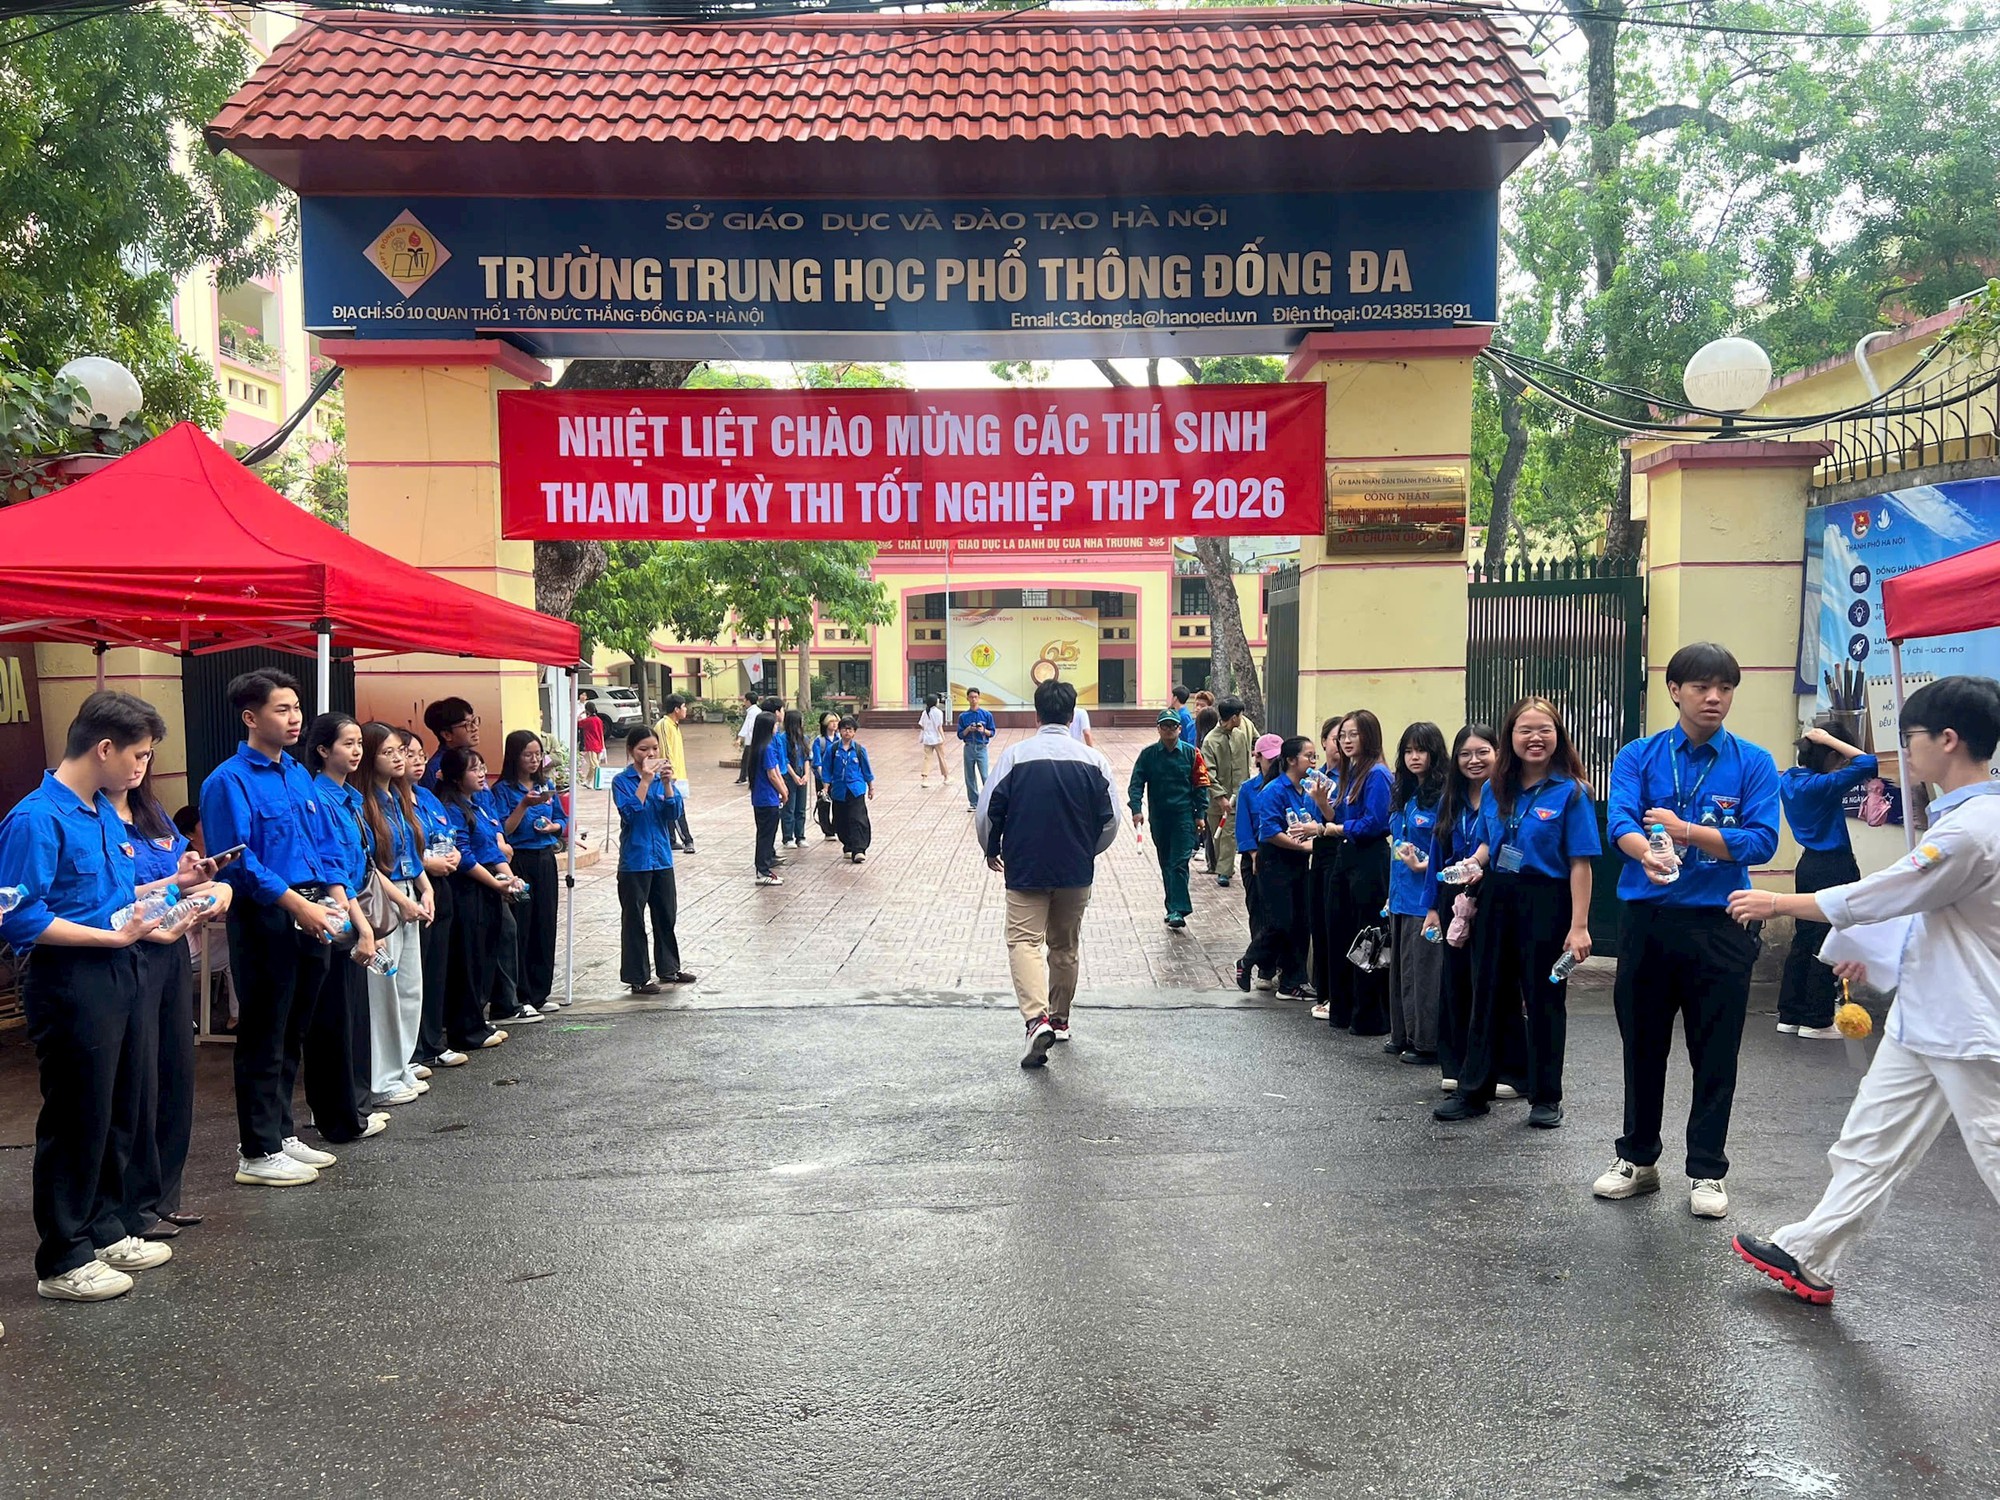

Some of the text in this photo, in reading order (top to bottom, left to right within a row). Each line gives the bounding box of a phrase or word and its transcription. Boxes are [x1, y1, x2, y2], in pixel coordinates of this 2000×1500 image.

[665, 203, 1227, 236] SỞ GIÁO DỤC VÀ ĐÀO TẠO HÀ NỘI
[478, 236, 1413, 310] TRƯỜNG TRUNG HỌC PHỔ THÔNG ĐỐNG ĐA
[407, 307, 423, 319] 10
[426, 307, 468, 321] QUAN
[471, 301, 501, 320] THỔ
[503, 308, 510, 321] 1
[550, 305, 581, 321] ĐỨC
[686, 310, 707, 322] ĐA
[716, 306, 736, 323] HÀ
[739, 307, 764, 326] NỘI
[1272, 306, 1310, 324] Điện
[558, 403, 1266, 466] NHIỆT LIỆT CHÀO MỪNG CÁC THÍ SINH
[540, 482, 648, 523] THAM
[662, 479, 716, 532] DỰ
[726, 474, 773, 523] KỲ
[785, 483, 843, 523] THI
[856, 467, 923, 523] TỐT
[936, 473, 1074, 530] NGHIỆP
[1087, 479, 1180, 520] THPT
[1192, 477, 1284, 519] 2026
[1364, 490, 1395, 501] CÔNG
[1018, 538, 1044, 549] DANH
